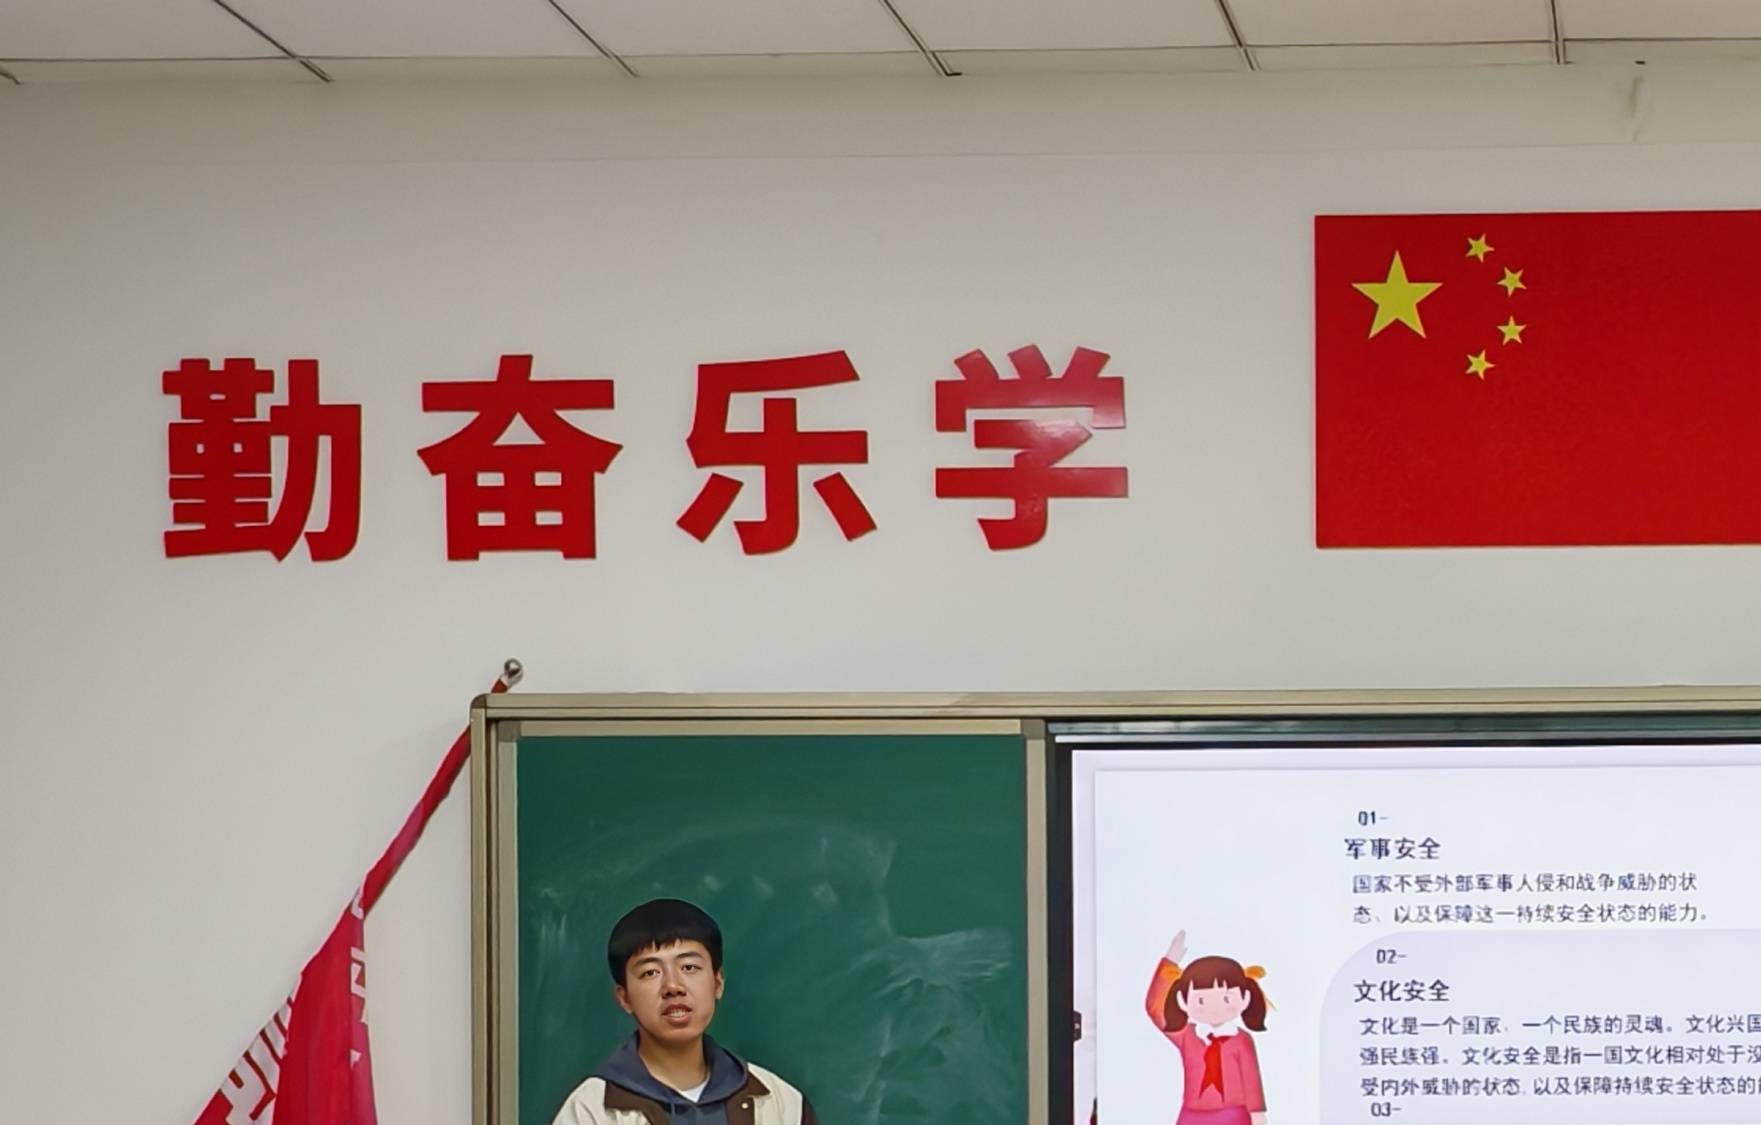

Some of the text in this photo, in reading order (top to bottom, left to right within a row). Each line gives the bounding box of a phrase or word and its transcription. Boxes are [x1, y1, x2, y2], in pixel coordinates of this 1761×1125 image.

[163, 345, 1128, 561] 勤奋乐学
[1344, 837, 1441, 861] 军事安全
[1354, 979, 1450, 1002] 文化安全
